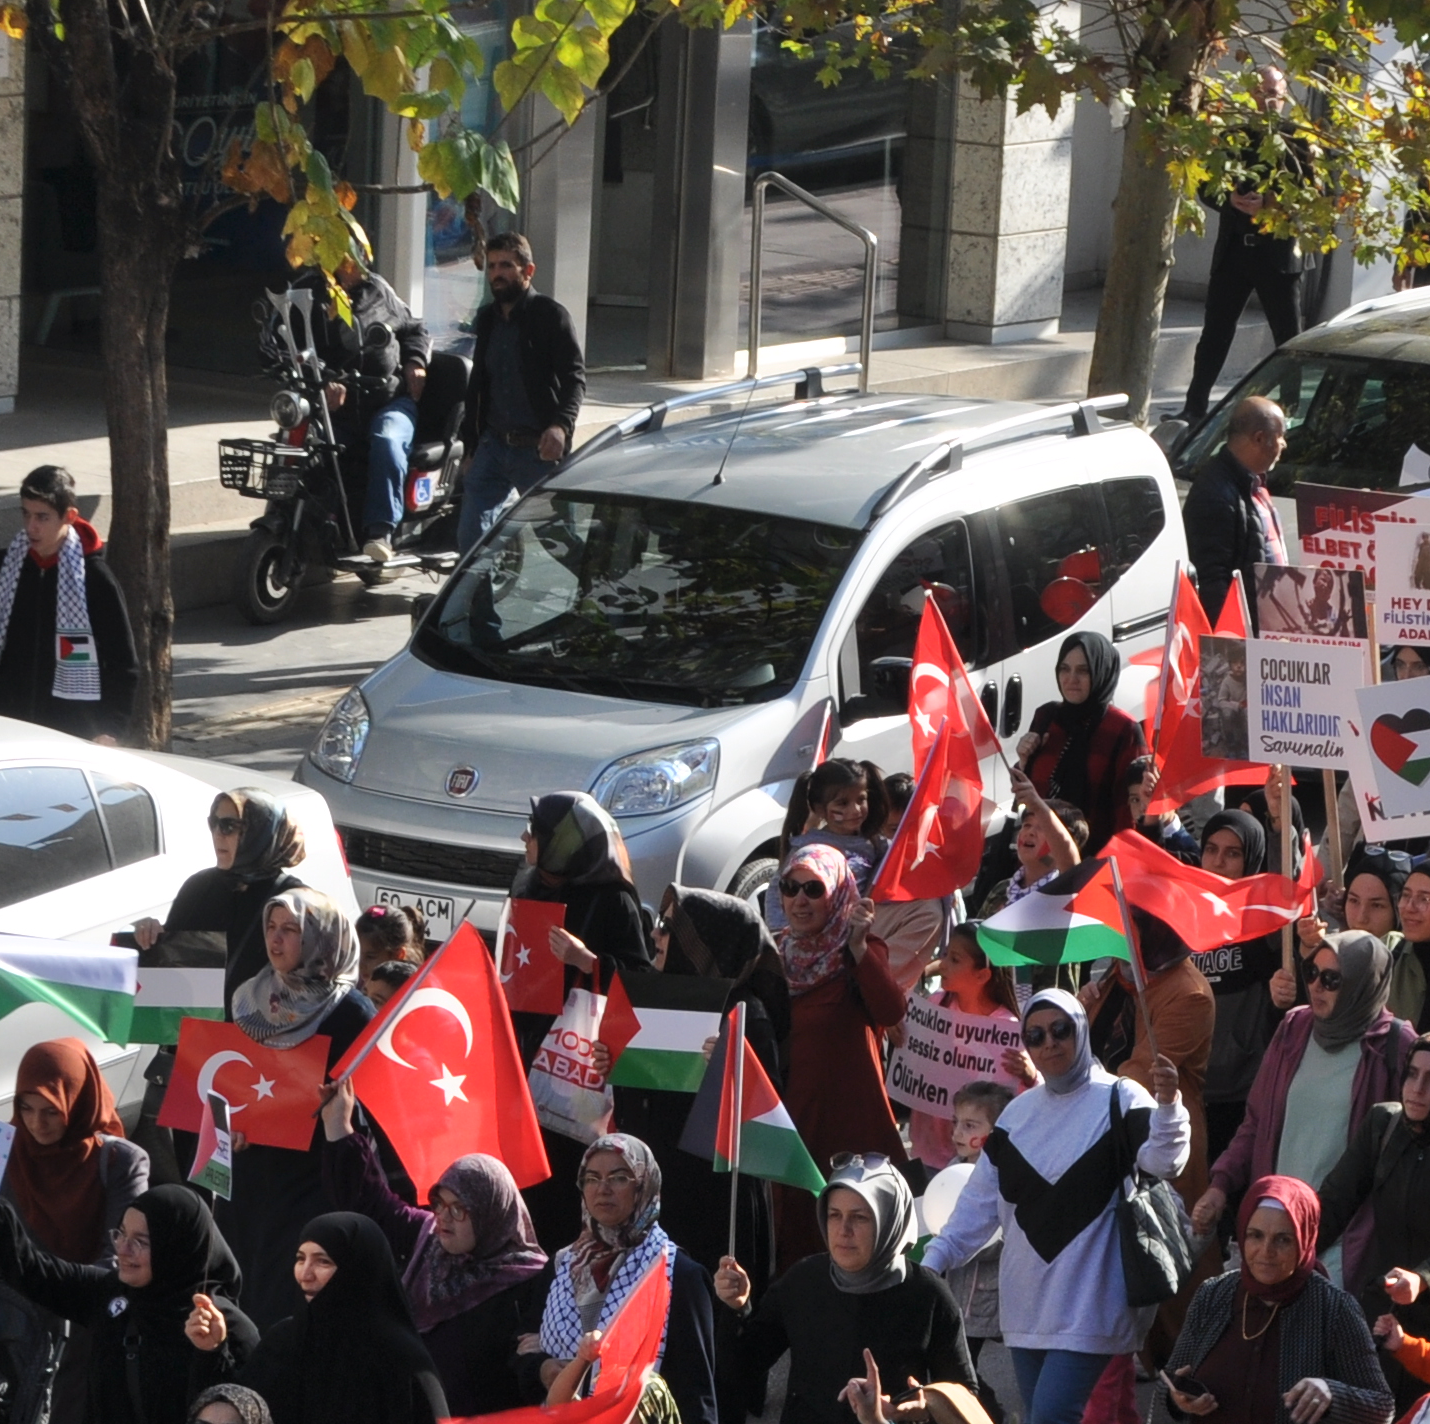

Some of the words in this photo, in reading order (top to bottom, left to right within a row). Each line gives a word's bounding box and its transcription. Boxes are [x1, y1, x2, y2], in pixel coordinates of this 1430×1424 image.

[1303, 535, 1362, 559] ELBET
[1391, 597, 1423, 611] HEY
[1260, 657, 1331, 687] ÇOCUKLAR
[1261, 682, 1301, 709] İNSAN
[451, 773, 472, 790] FIAT
[419, 898, 450, 920] ACM
[906, 997, 952, 1036] Çocuklar
[955, 1023, 1020, 1048] uyurken
[907, 1035, 940, 1062] sessiz
[943, 1046, 997, 1074] olunur.
[892, 1055, 948, 1106] Ölürken
